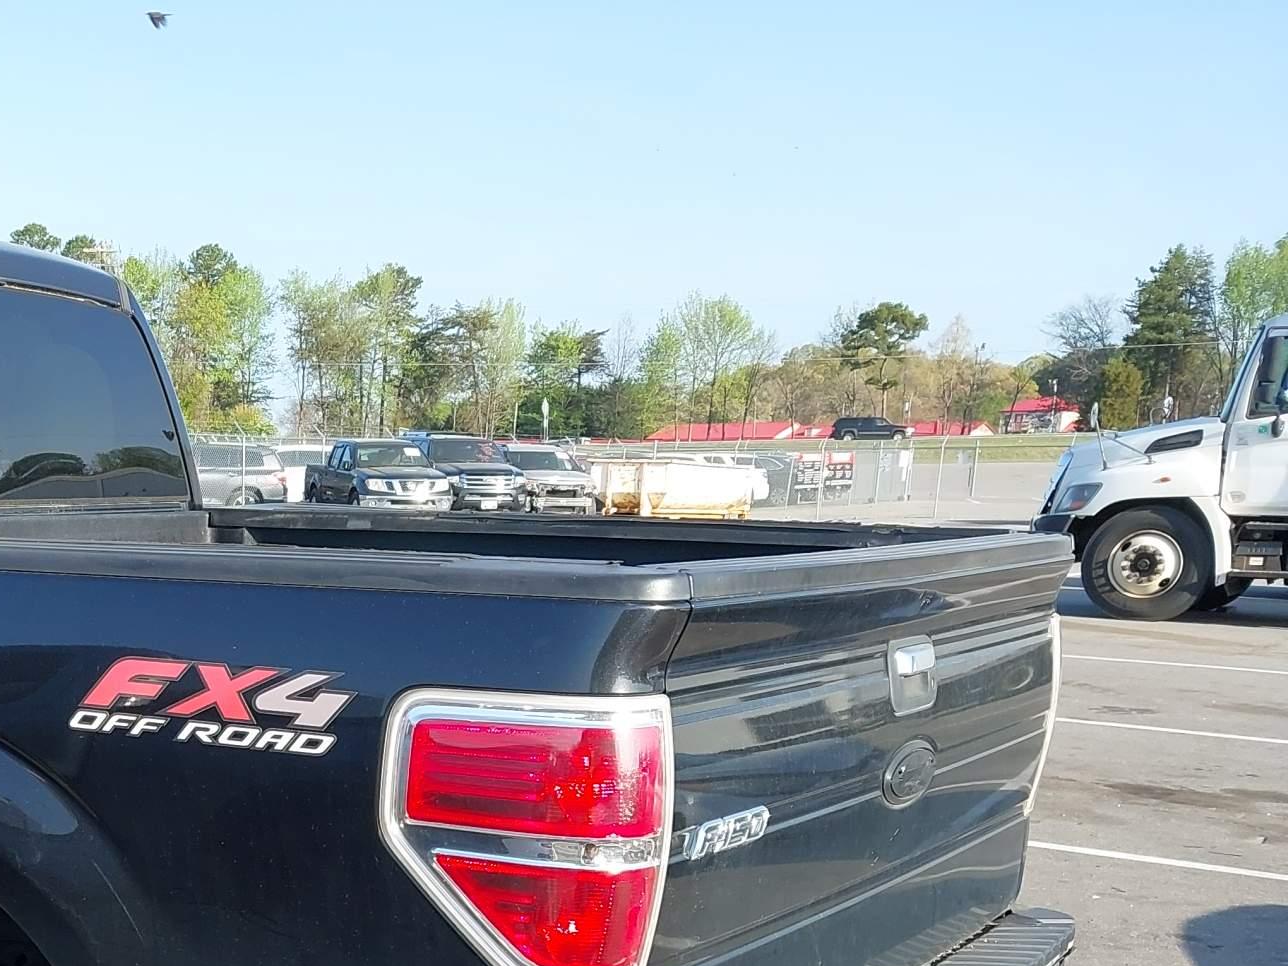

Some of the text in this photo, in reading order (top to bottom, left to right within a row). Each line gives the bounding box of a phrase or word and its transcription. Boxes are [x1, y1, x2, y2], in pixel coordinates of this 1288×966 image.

[79, 656, 358, 731] FX4
[69, 709, 337, 757] OFF ROAD
